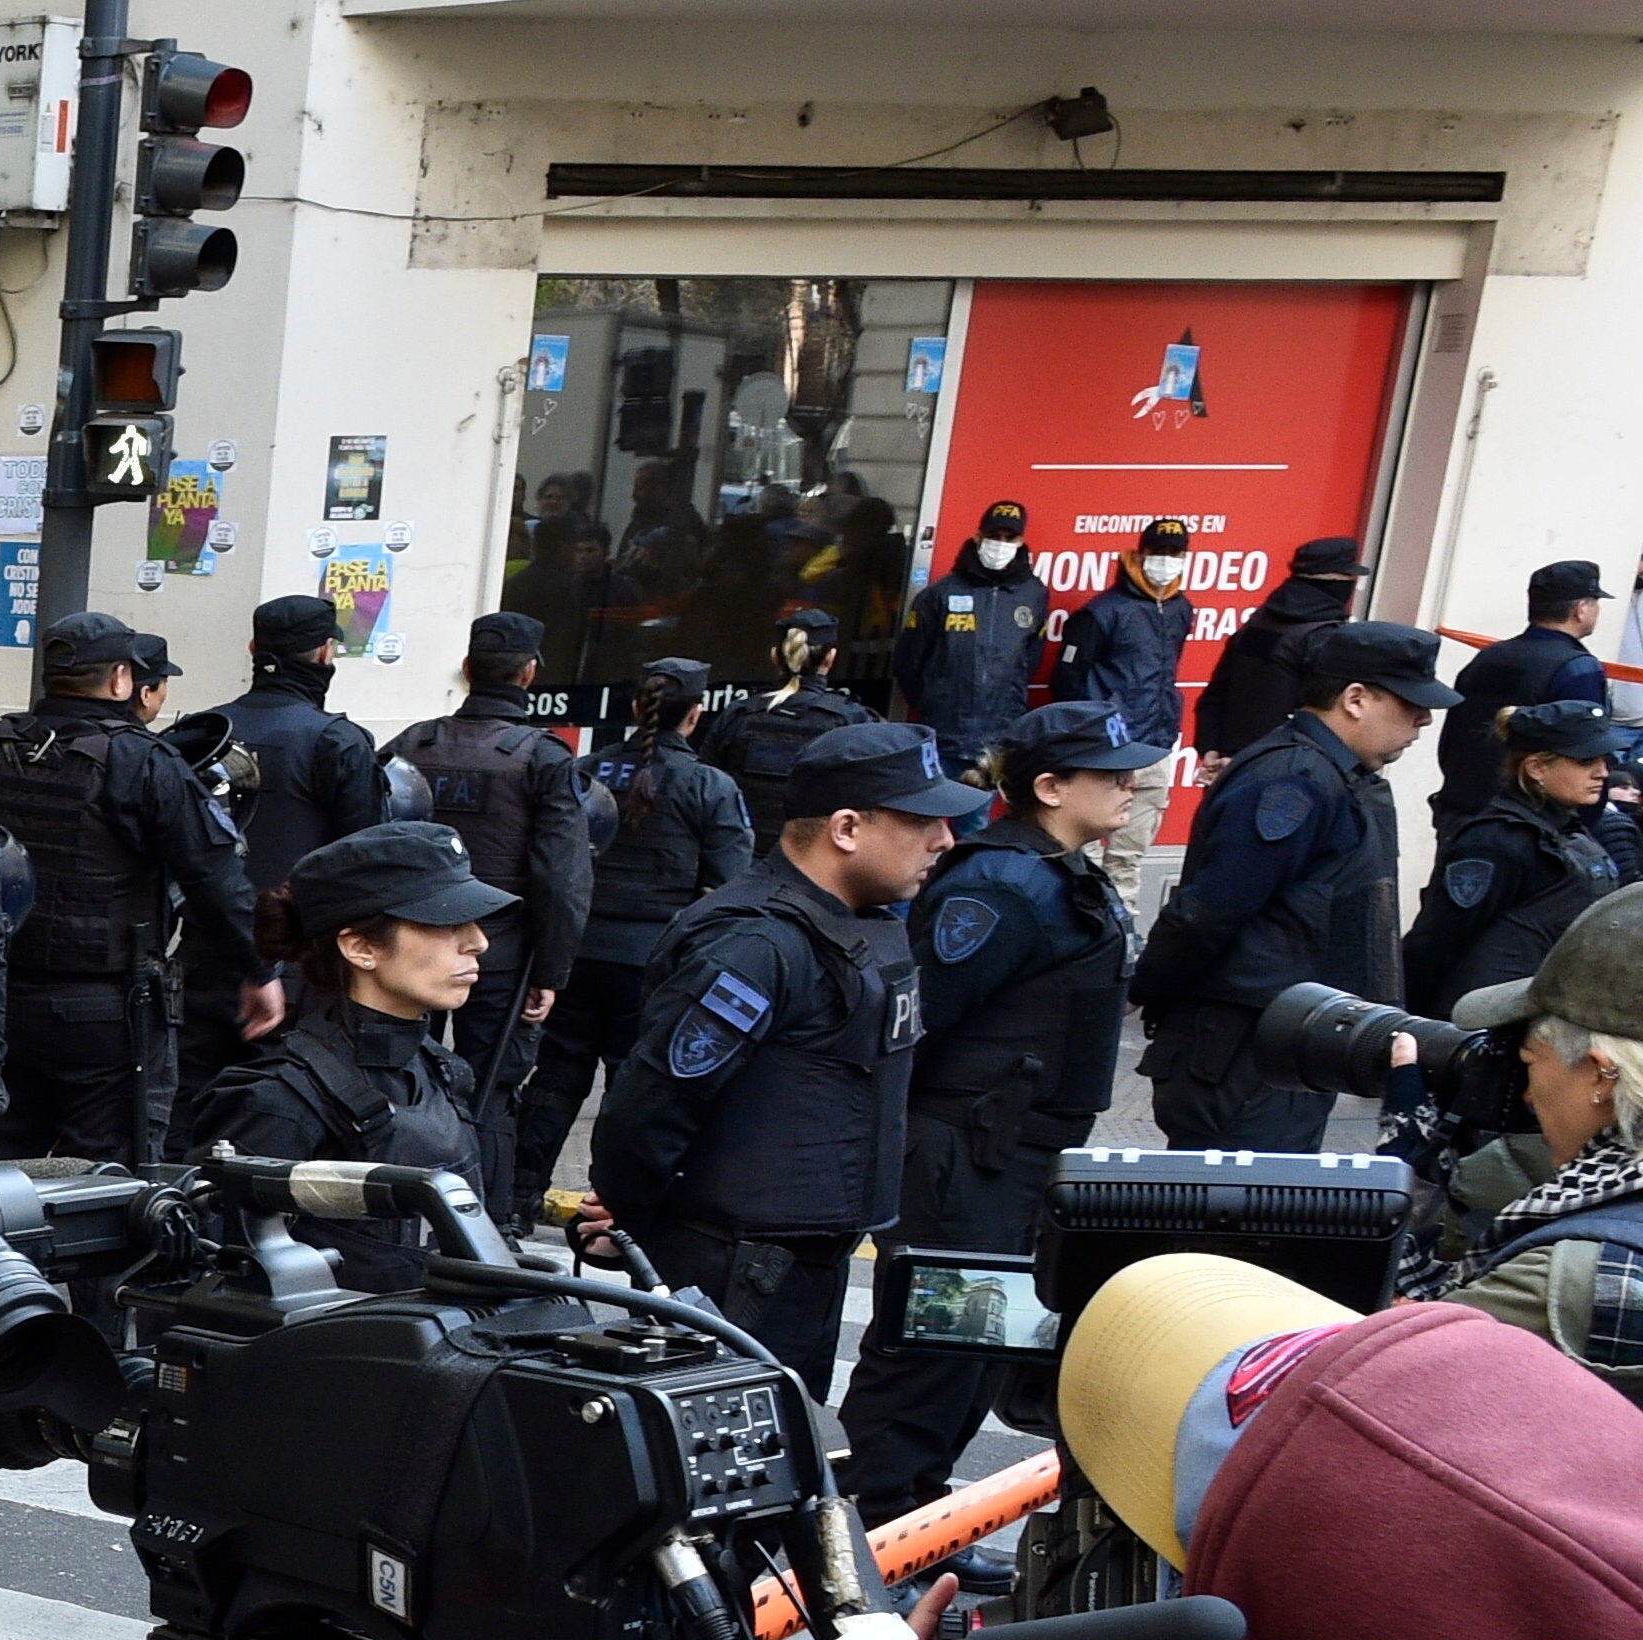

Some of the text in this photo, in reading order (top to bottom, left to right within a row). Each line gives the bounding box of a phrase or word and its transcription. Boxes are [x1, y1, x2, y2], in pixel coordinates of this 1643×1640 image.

[204, 476, 216, 492] A
[156, 491, 220, 510] PLANTA
[163, 508, 186, 526] YA
[992, 504, 1022, 520] PFA
[1156, 520, 1183, 535] PFA
[1200, 514, 1227, 534] EN
[326, 560, 388, 576] PASE A
[8, 581, 39, 599] NO SE
[324, 575, 390, 594] PLANTA
[332, 592, 356, 610] YA
[945, 613, 977, 632] PFA
[378, 1558, 397, 1610] C5N
